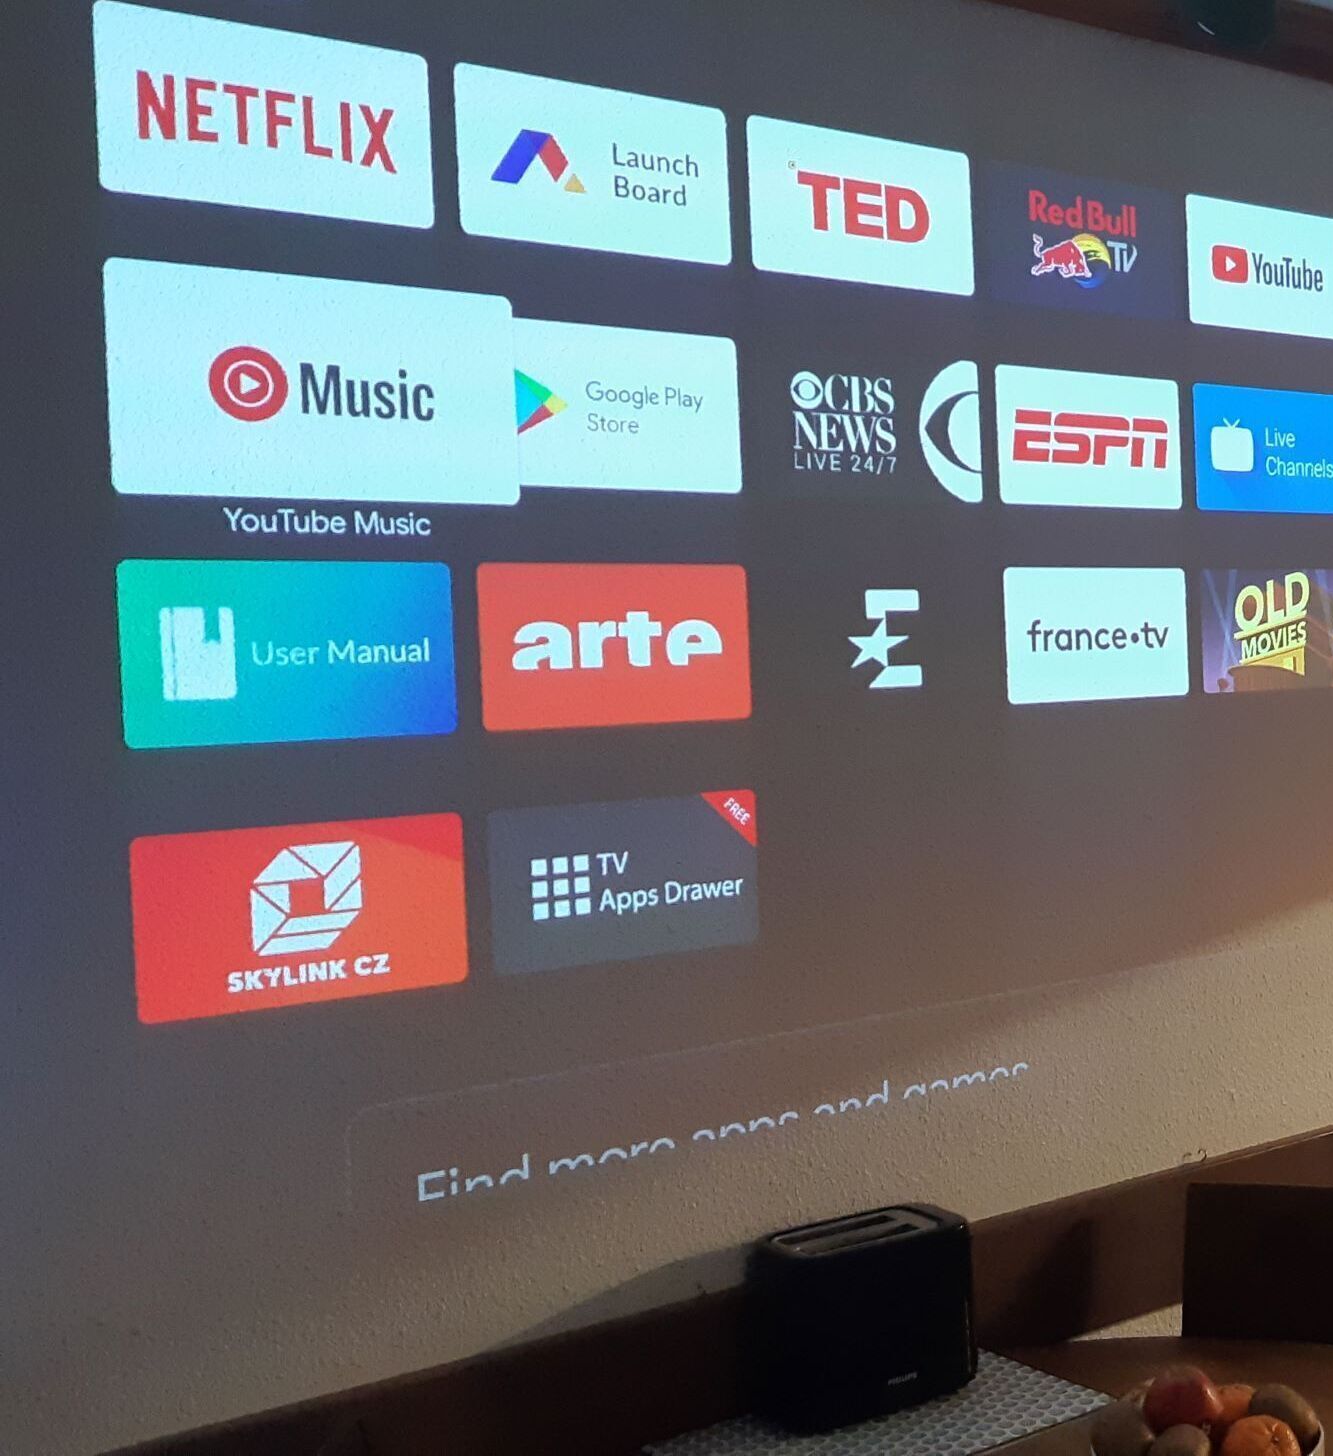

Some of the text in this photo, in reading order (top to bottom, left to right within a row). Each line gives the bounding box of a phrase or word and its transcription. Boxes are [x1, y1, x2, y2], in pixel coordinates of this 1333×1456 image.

[137, 70, 396, 174] NETFLIX
[613, 143, 699, 178] Launch
[614, 177, 687, 207] Board
[797, 171, 929, 243] TED
[1107, 241, 1137, 273] TV
[1252, 253, 1323, 292] YouTube
[300, 363, 434, 421] Music
[586, 381, 703, 413] Google Play
[824, 374, 894, 414] CBS
[587, 413, 639, 434] Store
[793, 410, 896, 454] NEWS
[1013, 409, 1168, 468] ESPN
[1265, 428, 1295, 448] Live
[795, 453, 896, 474] LIVE 24/7
[1265, 456, 1333, 478] Channels
[223, 507, 431, 535] YouTube Music
[1233, 571, 1310, 631] OLD
[252, 637, 430, 666] User Manual
[512, 612, 722, 670] arte
[1242, 621, 1307, 660] MOVIES
[723, 797, 751, 826] FREE
[596, 851, 628, 875] TV
[600, 879, 743, 915] Apps Drawer
[227, 954, 390, 993] SKYLINK CZ
